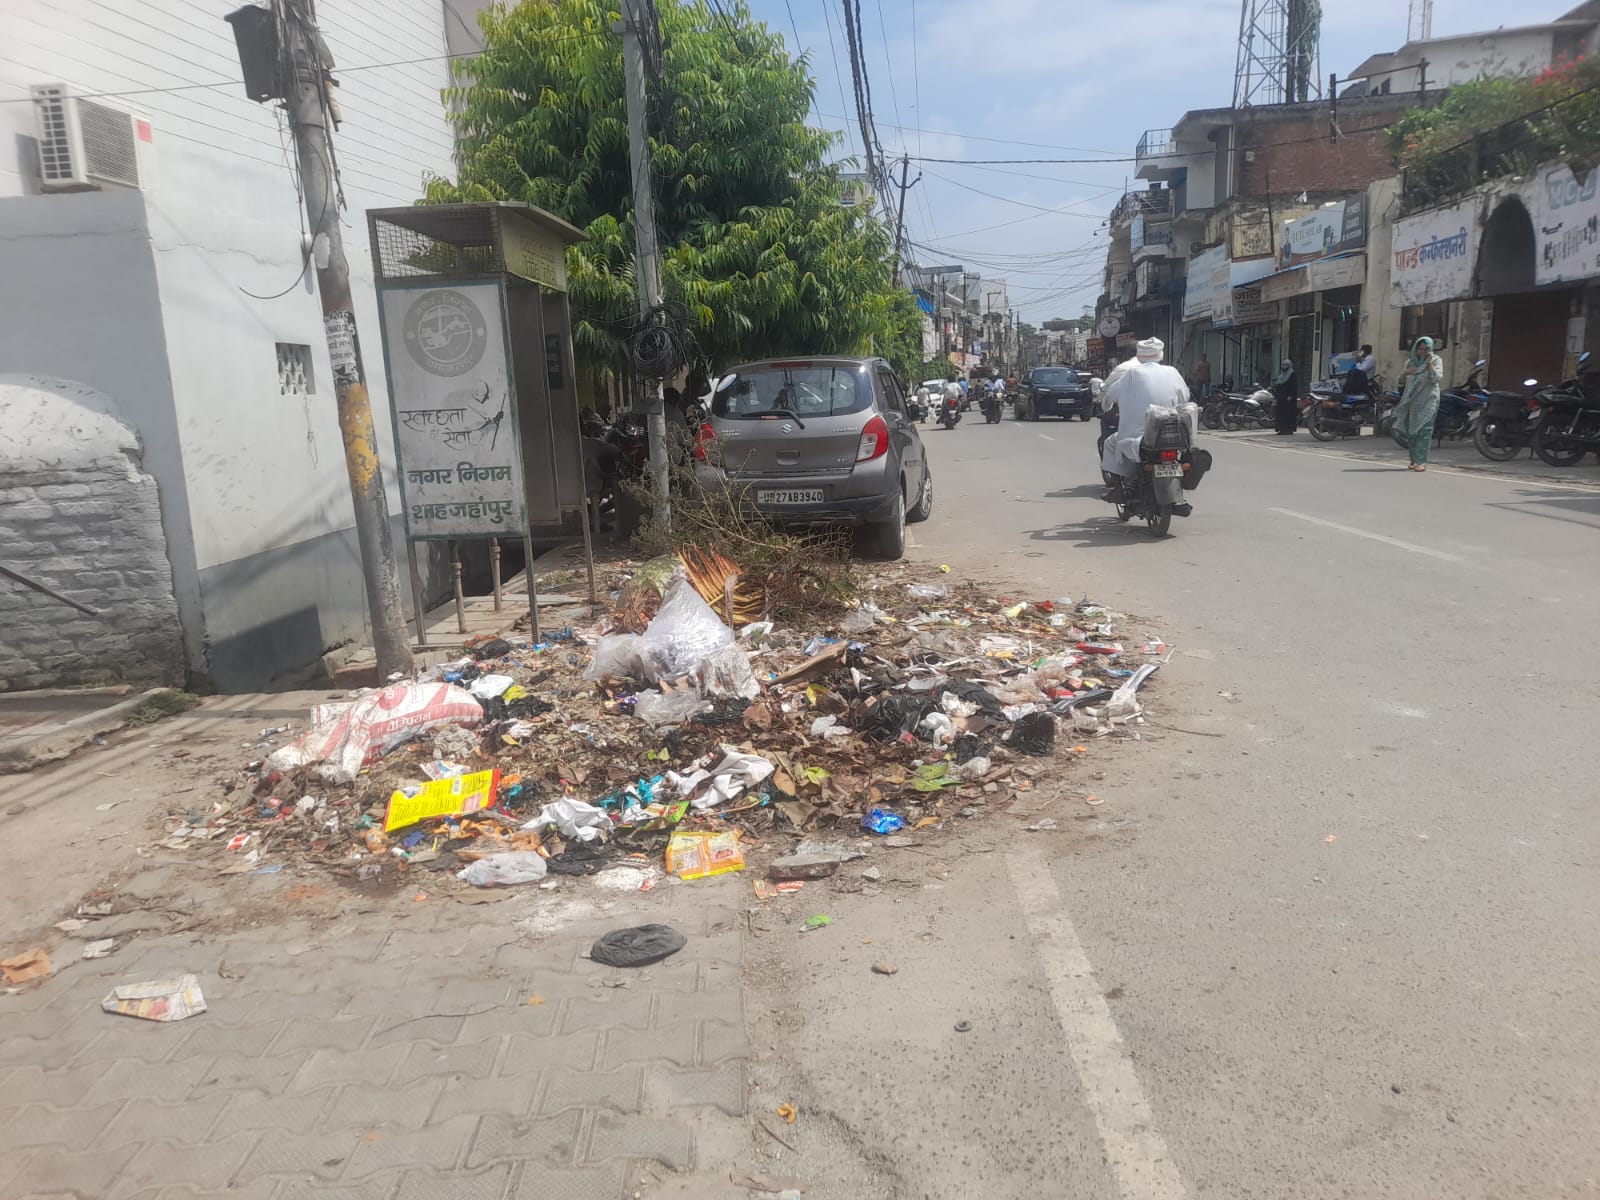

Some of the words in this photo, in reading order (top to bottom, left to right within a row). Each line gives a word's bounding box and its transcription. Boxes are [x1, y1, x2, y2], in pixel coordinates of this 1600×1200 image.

[407, 469, 452, 486] नगर
[456, 461, 512, 486] निगम
[412, 496, 513, 524] शाहजहांपुर
